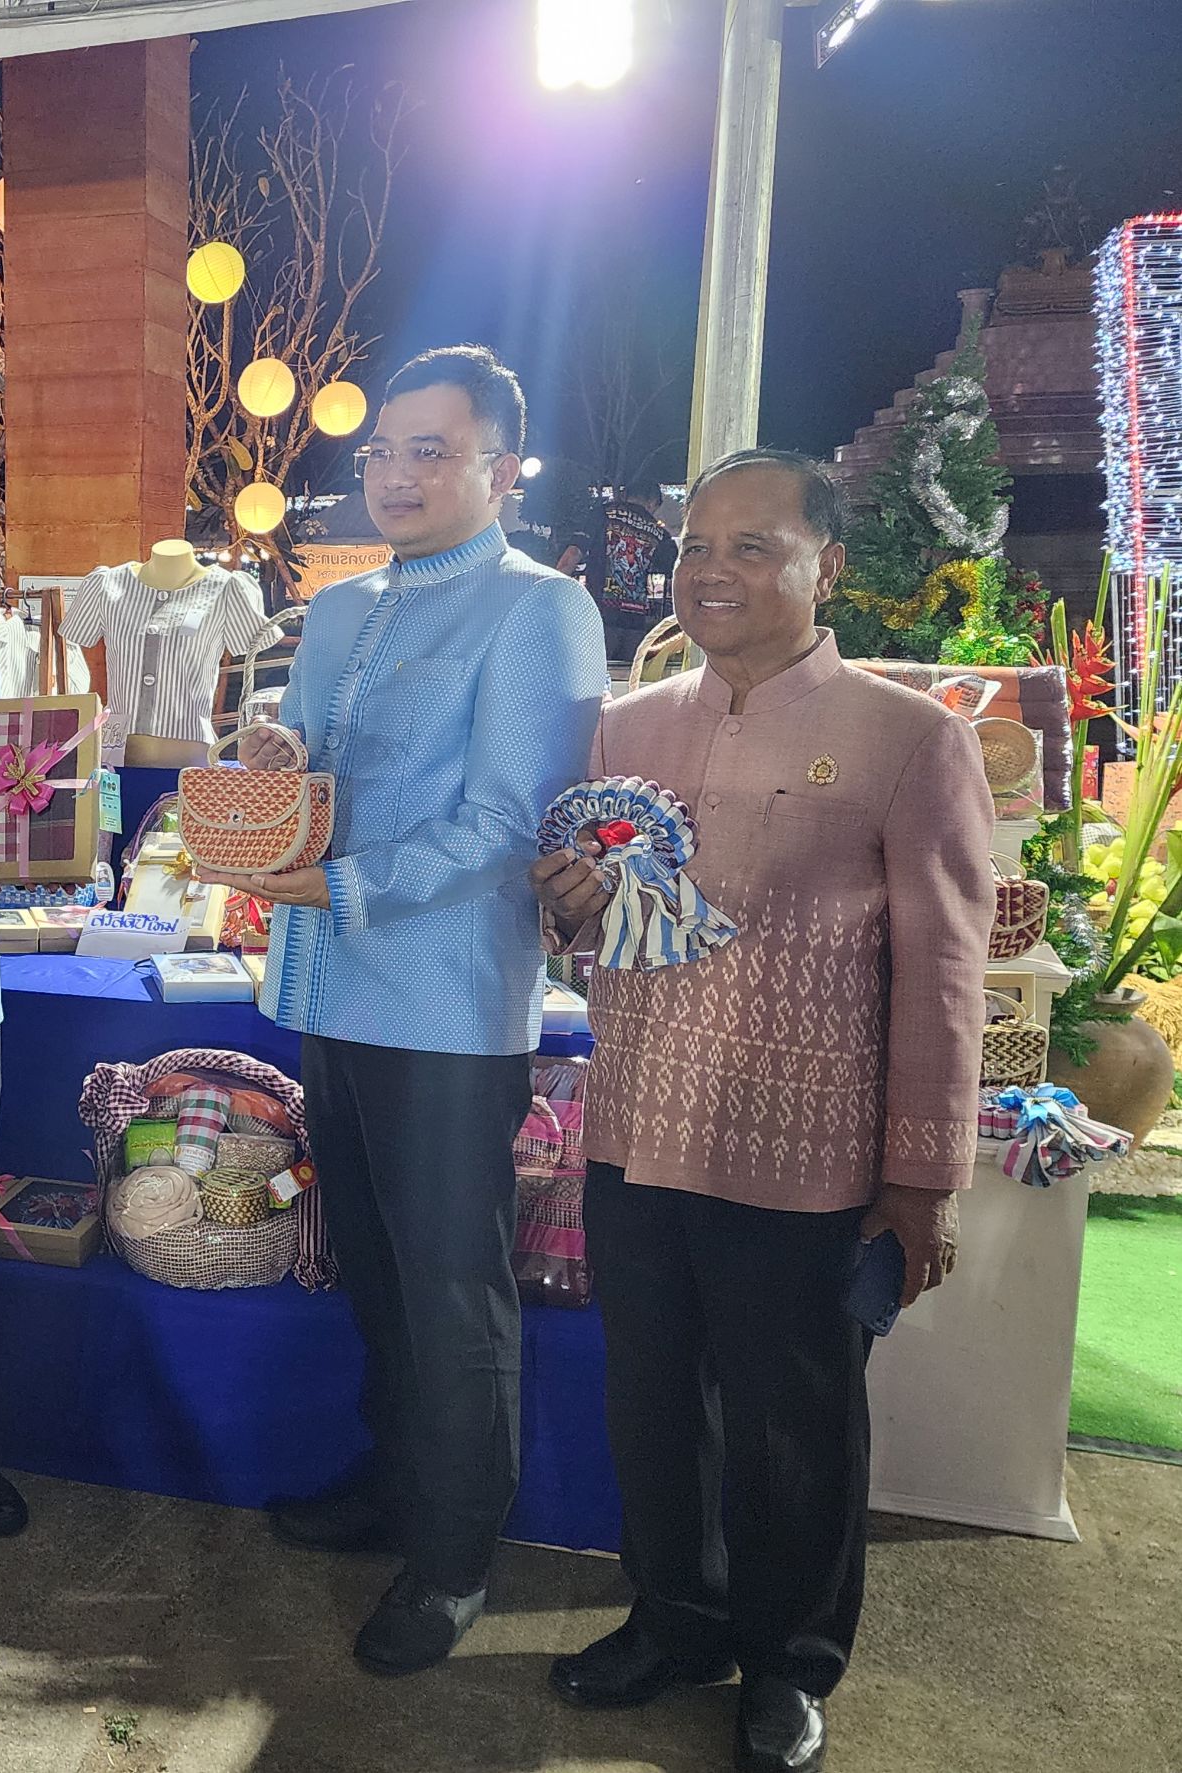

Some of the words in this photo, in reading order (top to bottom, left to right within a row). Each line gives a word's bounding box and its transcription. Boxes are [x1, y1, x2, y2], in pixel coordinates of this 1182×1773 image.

[91, 913, 179, 932] สวัสดีปีใหม่
